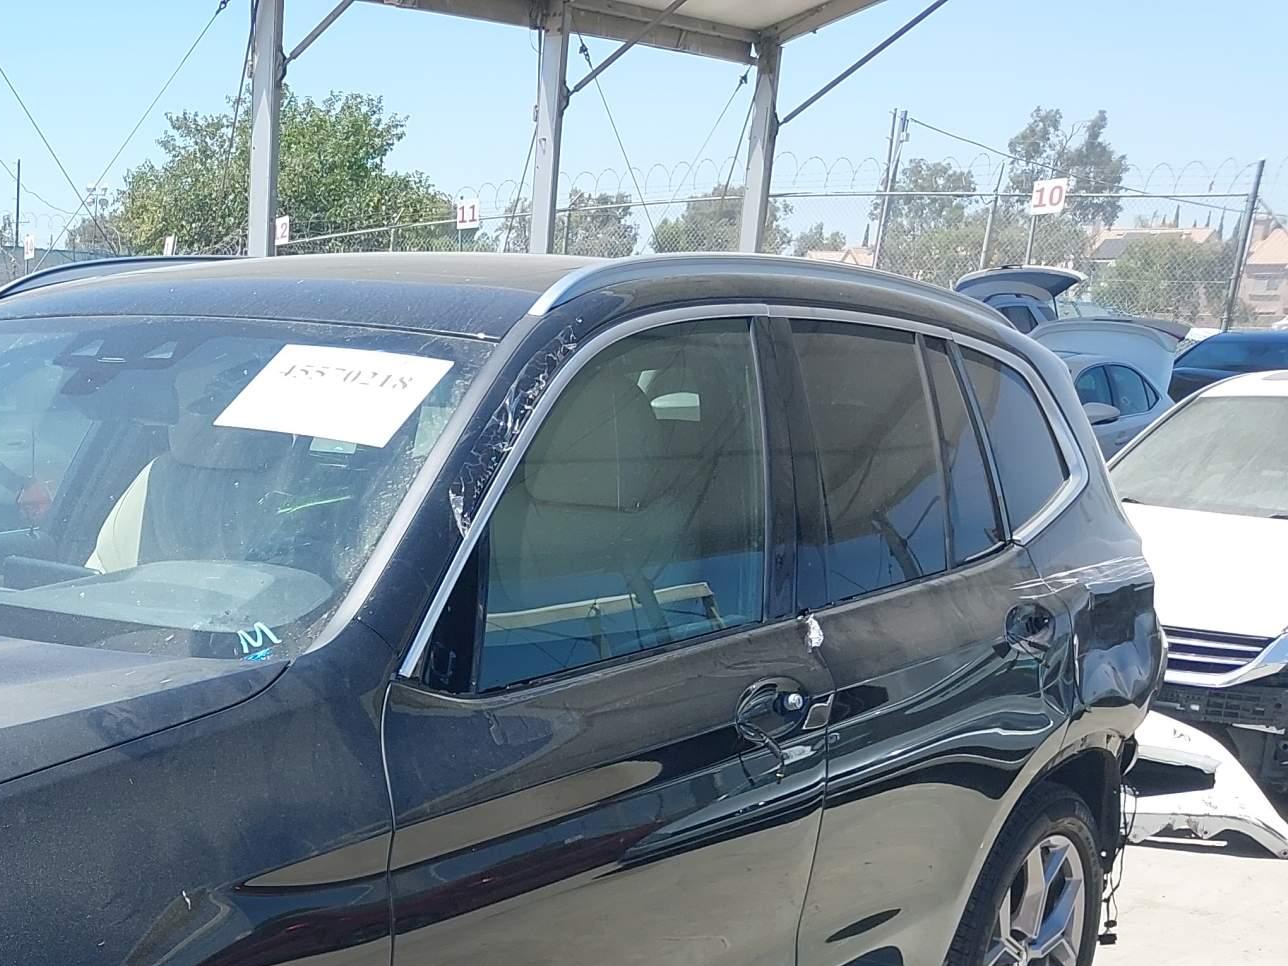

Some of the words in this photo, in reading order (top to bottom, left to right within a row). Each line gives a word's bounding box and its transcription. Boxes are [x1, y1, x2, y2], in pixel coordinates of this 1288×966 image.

[1033, 185, 1063, 208] 10
[458, 204, 477, 223] 11
[275, 222, 287, 239] 2
[237, 621, 282, 654] M
